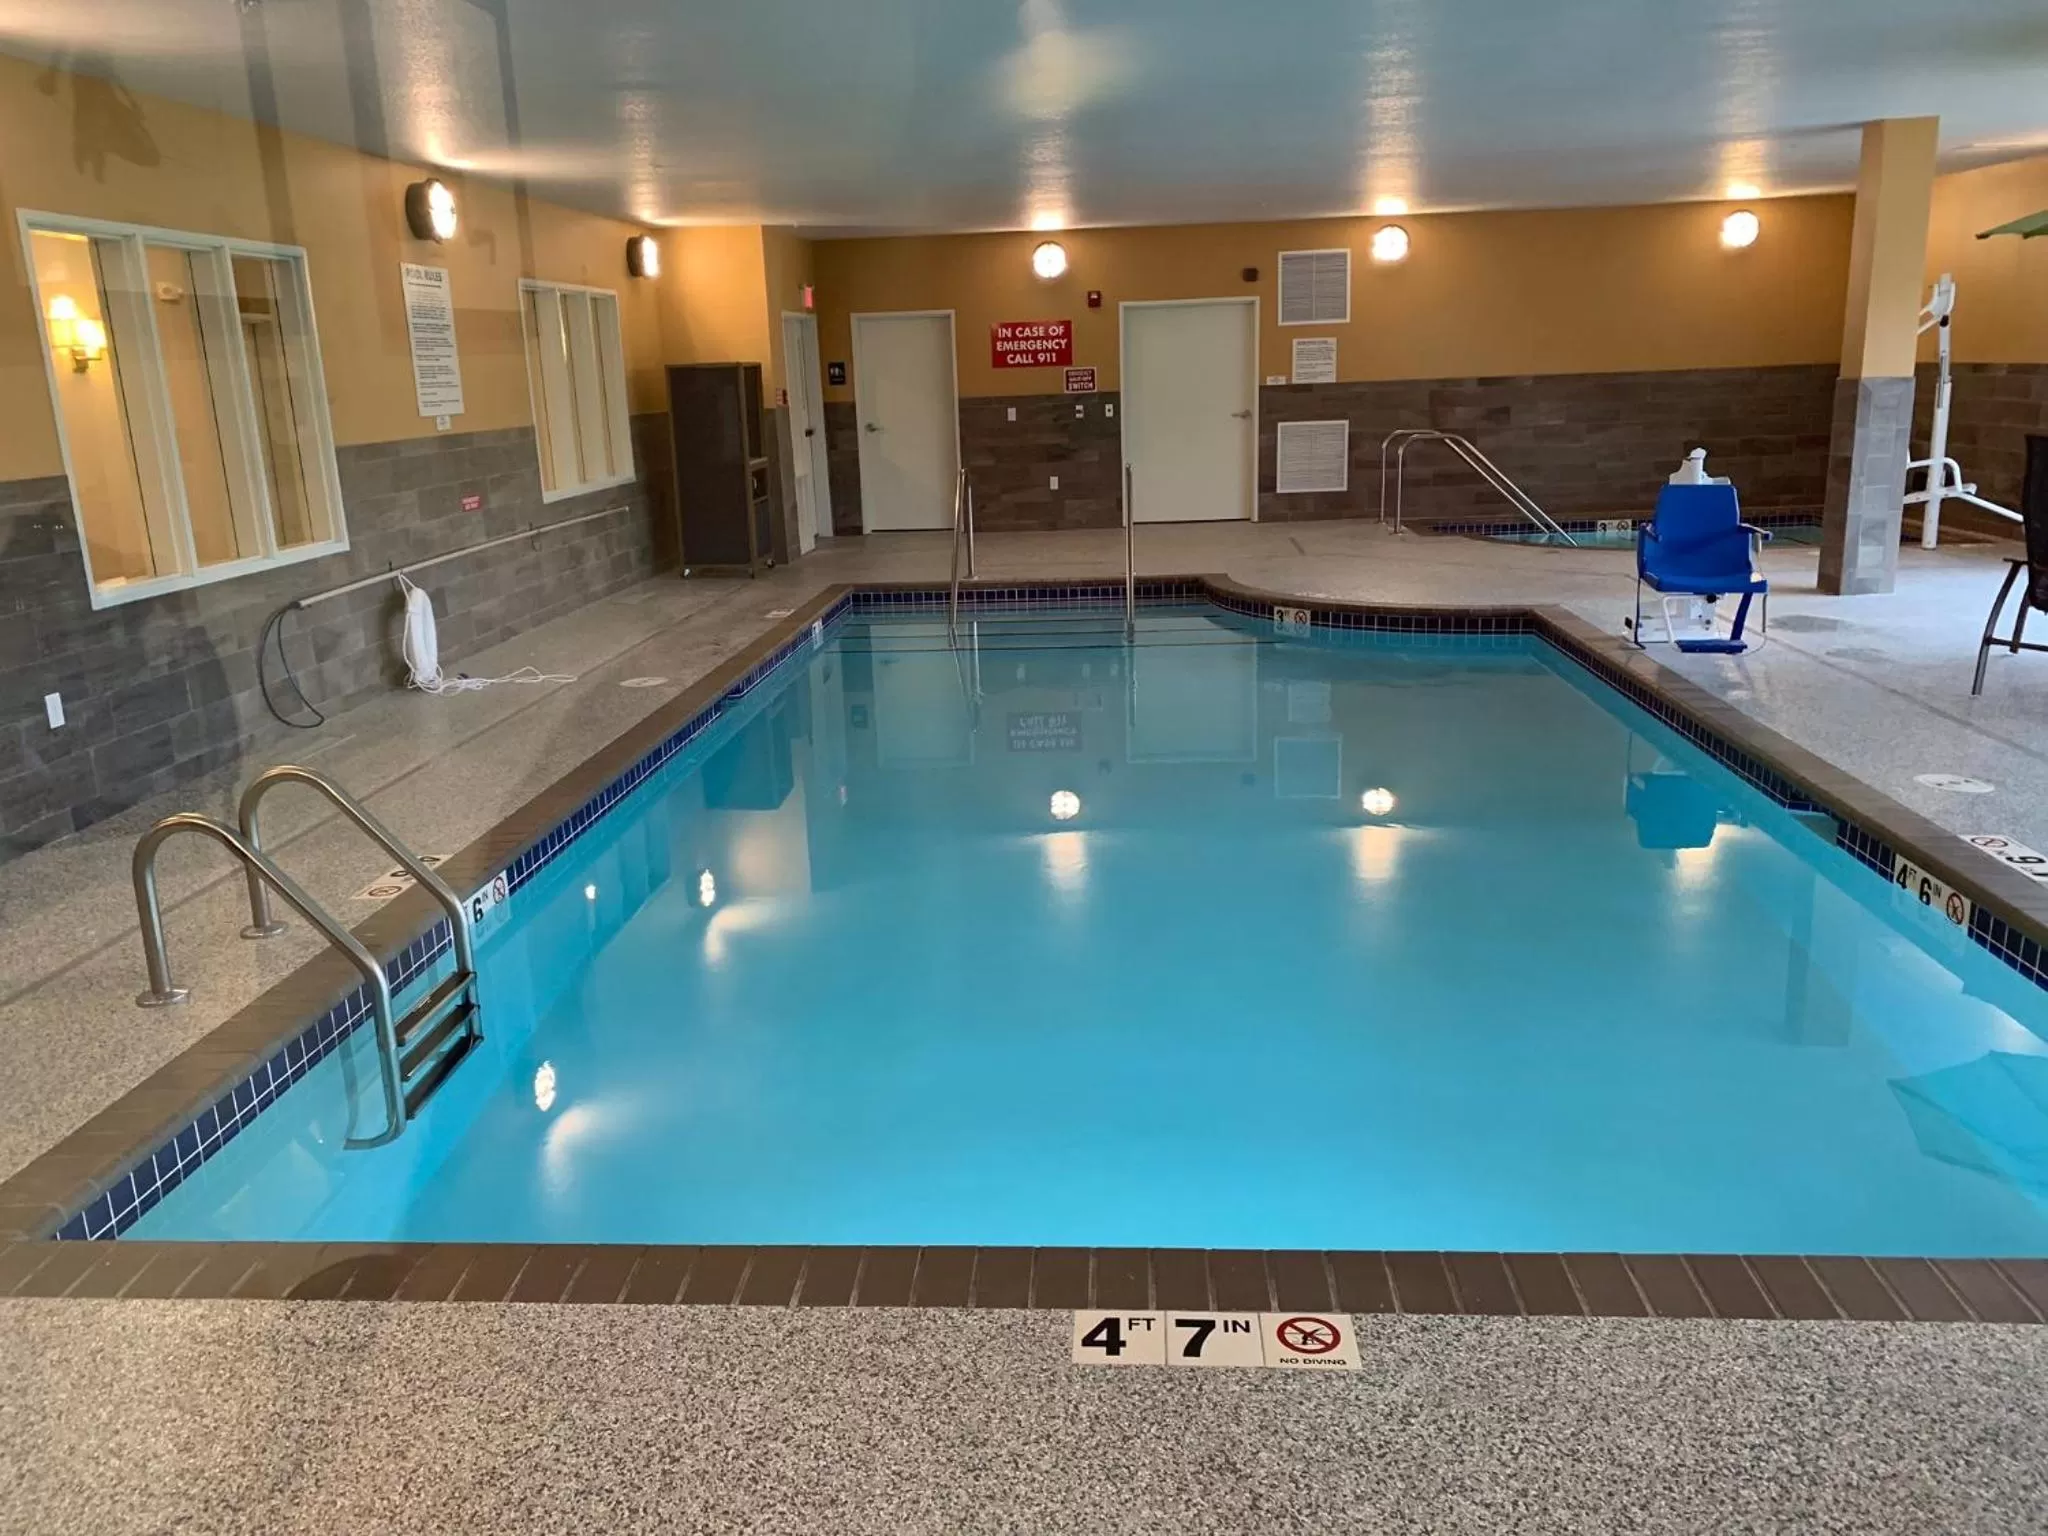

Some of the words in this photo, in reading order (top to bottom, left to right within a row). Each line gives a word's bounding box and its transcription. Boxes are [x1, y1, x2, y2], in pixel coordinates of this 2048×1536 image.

[998, 327, 1012, 338] IN
[1015, 325, 1045, 337] CASE
[1048, 325, 1066, 336] OF
[996, 339, 1068, 351] EMERGENCY
[1006, 353, 1035, 364] CALL
[1037, 352, 1057, 362] 911
[1276, 609, 1284, 623] 3
[1896, 863, 1908, 889] 4
[1919, 877, 1932, 906] 6
[473, 897, 484, 923] 6
[1081, 1317, 1127, 1356] 4
[1128, 1317, 1157, 1331] FT
[1175, 1318, 1216, 1358] 7
[1223, 1319, 1251, 1333] IN
[1280, 1357, 1300, 1365] NO
[1303, 1358, 1348, 1366] DIVING
